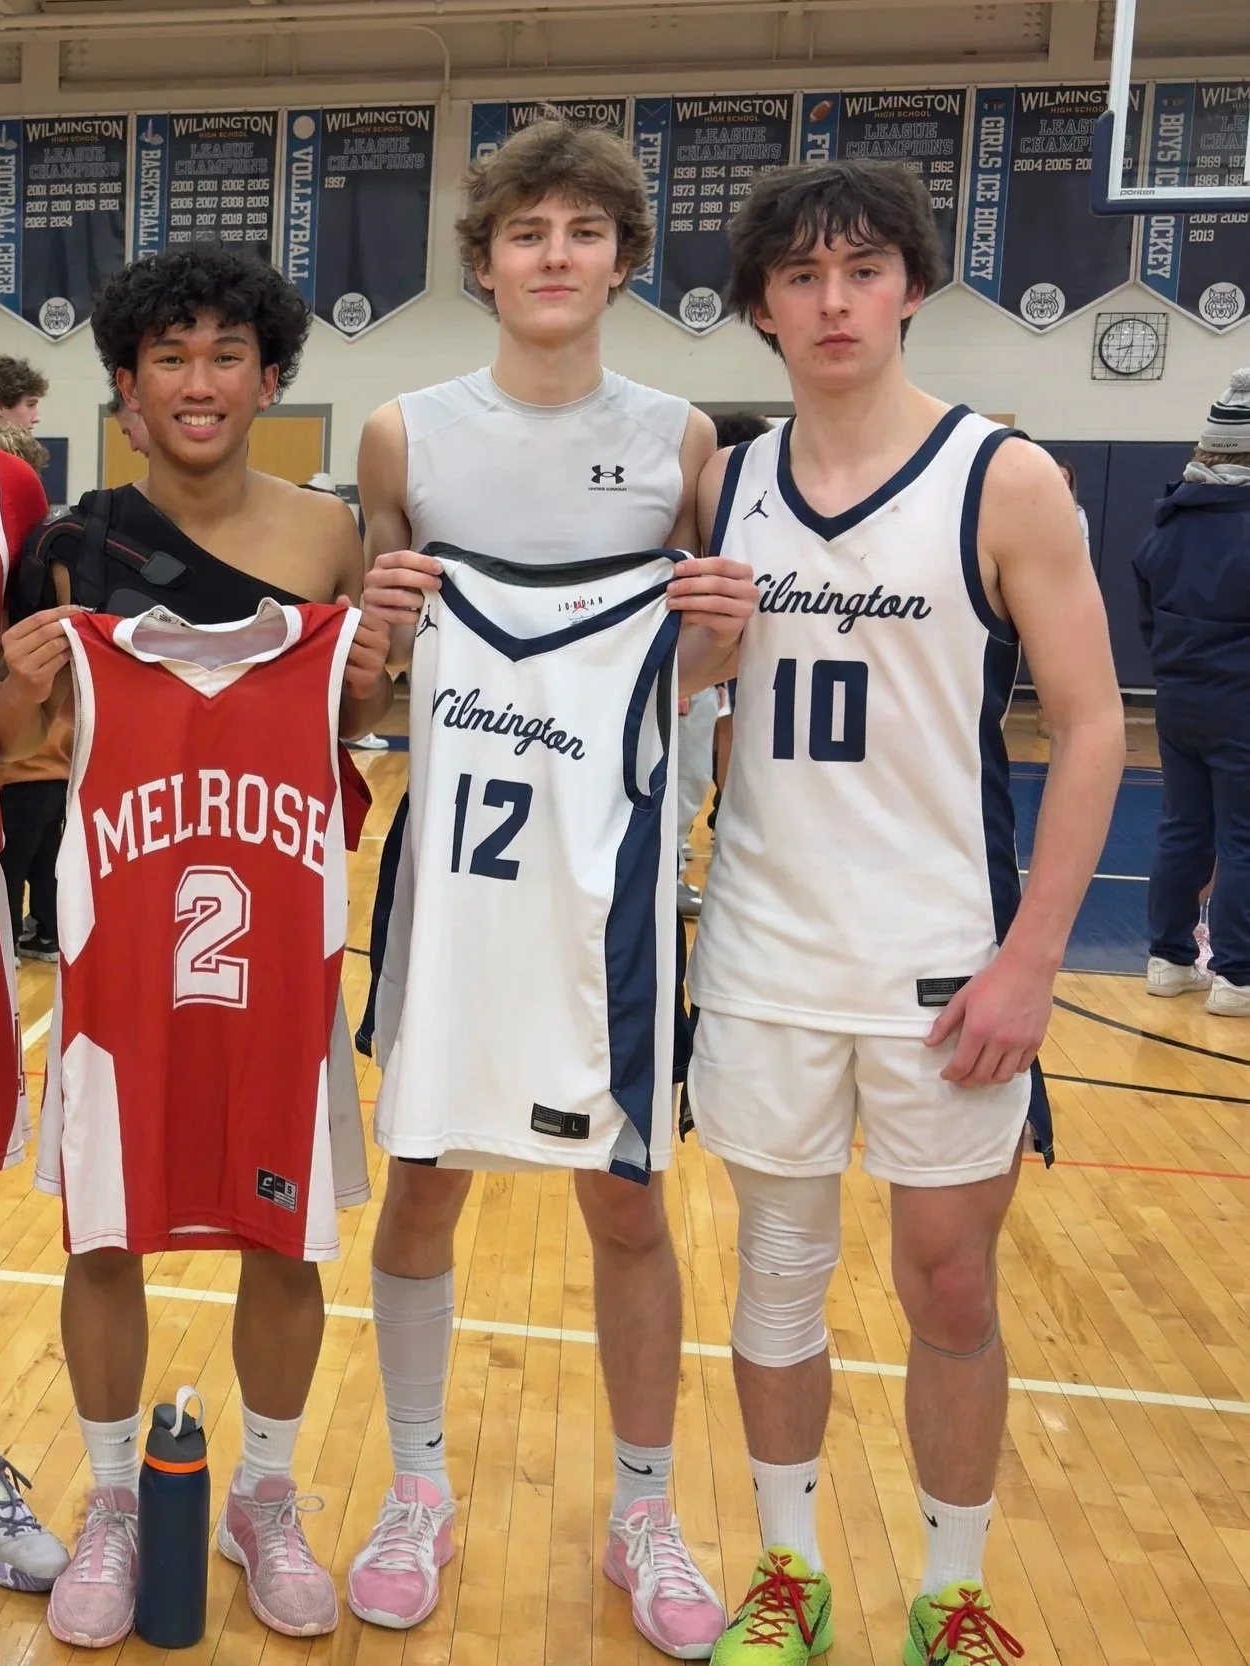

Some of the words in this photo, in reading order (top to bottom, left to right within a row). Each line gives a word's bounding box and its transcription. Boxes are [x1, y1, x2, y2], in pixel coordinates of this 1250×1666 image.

[677, 100, 788, 122] WILMINGTON
[846, 94, 960, 118] WILMINGTON
[173, 116, 273, 138] WILMINGTON
[326, 110, 430, 132] WILMINGTON
[27, 120, 123, 142] WILMINGTON
[695, 127, 766, 144] LEAGUE
[864, 122, 938, 140] LEAGUE
[1157, 112, 1185, 162] BOYS
[190, 142, 254, 158] LEAGUE
[344, 137, 410, 154] LEAGUE
[846, 139, 954, 158] CHAMPIONS
[979, 116, 1005, 168] GIRLS
[44, 146, 106, 163] LEAGUE
[677, 144, 782, 162] CHAMPIONS
[30, 162, 120, 179] CHAMPIONS
[175, 158, 268, 176] CHAMPIONS
[327, 154, 424, 172] CHAMPIONS
[930, 161, 954, 173] 1962
[1014, 158, 1042, 172] 2004
[1045, 158, 1072, 170] 2005
[1196, 156, 1221, 168] 1969
[674, 167, 696, 178] 1938
[701, 166, 726, 178] 1954
[730, 166, 753, 178] 1956
[1194, 174, 1220, 186] 1983
[1224, 174, 1243, 186] 198
[27, 184, 46, 196] 2001
[50, 184, 72, 196] 2004
[74, 182, 96, 194] 2005
[99, 182, 122, 194] 2006
[171, 180, 194, 192] 2000
[197, 180, 218, 192] 2001
[221, 179, 244, 191] 2002
[247, 178, 270, 190] 2005
[324, 176, 346, 188] 1997
[672, 185, 695, 196] 1973
[700, 184, 724, 196] 1974
[730, 184, 752, 196] 1975
[930, 179, 952, 192] 1972
[976, 173, 1001, 202] ICE
[26, 201, 48, 212] 2007
[51, 200, 71, 212] 2010
[99, 199, 119, 210] 2021
[139, 150, 161, 246] BASKETBALL
[196, 197, 218, 208] 2007
[246, 196, 270, 208] 2009
[288, 146, 313, 284] VOLLEYBALL
[671, 202, 694, 214] 1977
[700, 202, 722, 214] 1980
[25, 216, 47, 228] 2022
[50, 216, 72, 228] 2024
[171, 214, 192, 226] 2010
[196, 214, 216, 226] 2017
[221, 213, 242, 224] 2018
[246, 212, 268, 224] 2019
[670, 220, 693, 232] 1985
[698, 220, 722, 231] 1987
[220, 230, 243, 240] 2022
[246, 230, 268, 240] 2023
[970, 207, 998, 280] HOCKEY
[1189, 230, 1215, 242] 2013
[1147, 215, 1175, 280] OCKEY
[755, 571, 932, 634] ilmington
[772, 658, 868, 762] 10
[92, 769, 326, 880] MELROSE
[450, 773, 534, 881] 12
[173, 865, 252, 1010] 2
[572, 1120, 578, 1131] L
